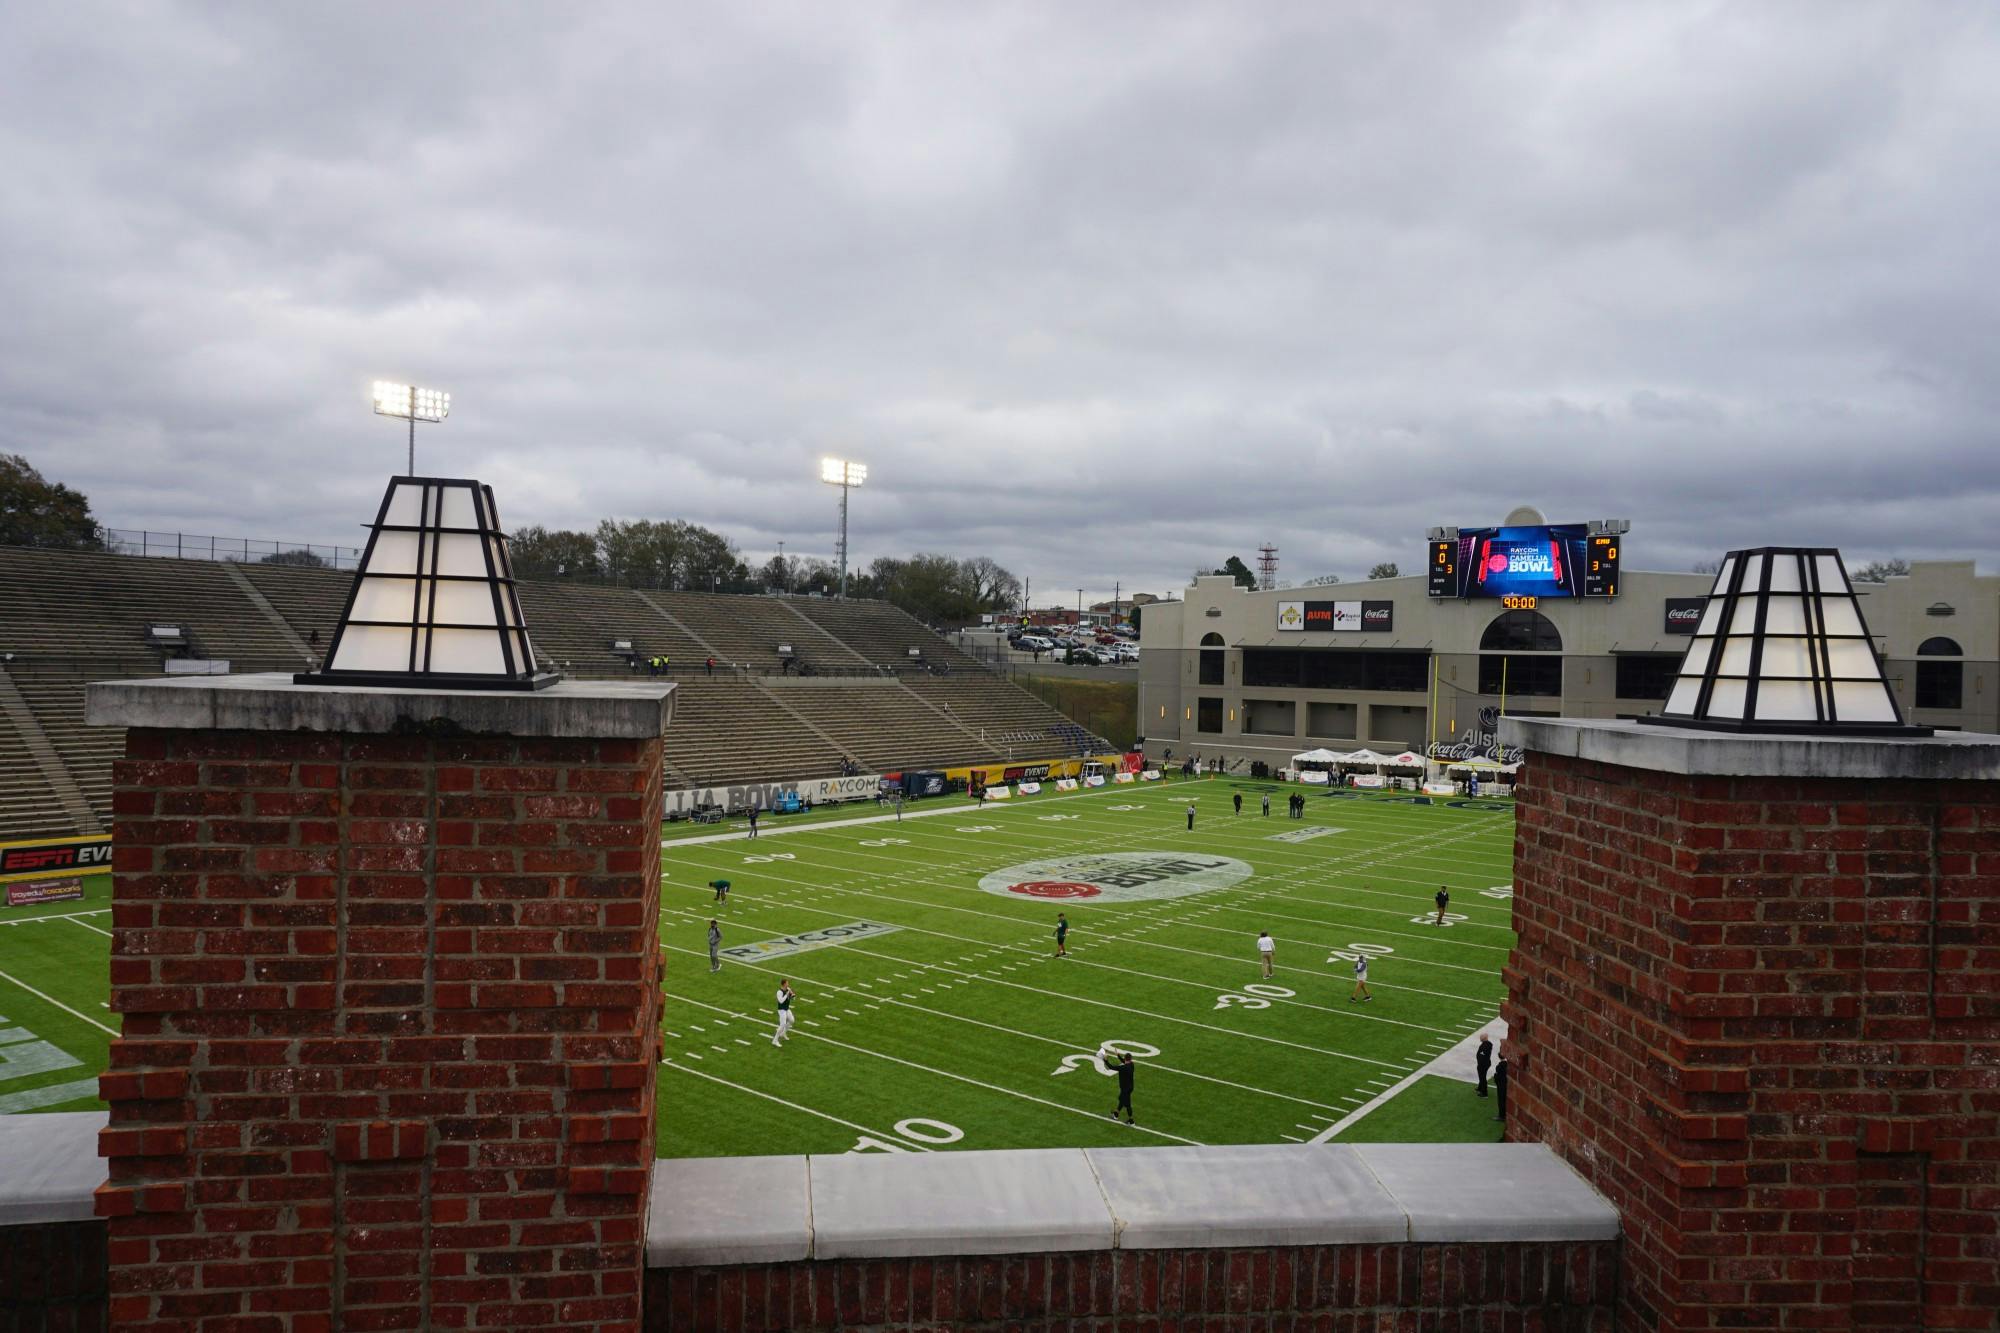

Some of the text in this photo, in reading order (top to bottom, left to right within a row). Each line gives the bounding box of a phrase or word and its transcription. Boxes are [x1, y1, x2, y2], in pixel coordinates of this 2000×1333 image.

[1439, 552, 1446, 564] 0
[1510, 554, 1548, 562] CAMELLIA
[1608, 547, 1617, 559] 0
[1447, 564, 1453, 574] 3
[1508, 560, 1554, 573] BOWL
[1592, 560, 1599, 571] 3
[1609, 584, 1614, 595] 1
[1307, 610, 1332, 620] AUM
[1365, 609, 1389, 619] Coca-Cola
[1668, 609, 1700, 619] Coca-Cola
[1427, 742, 1477, 759] Coca-Cola
[1024, 766, 1049, 777] EVENTS
[820, 778, 876, 794] RAYCOM
[5, 848, 75, 869] ESPN
[1086, 860, 1231, 888] BOWL
[722, 922, 884, 957] RAYCOM
[1217, 984, 1296, 1009] 30
[1061, 1039, 1161, 1077] 20
[852, 1118, 964, 1153] 10
